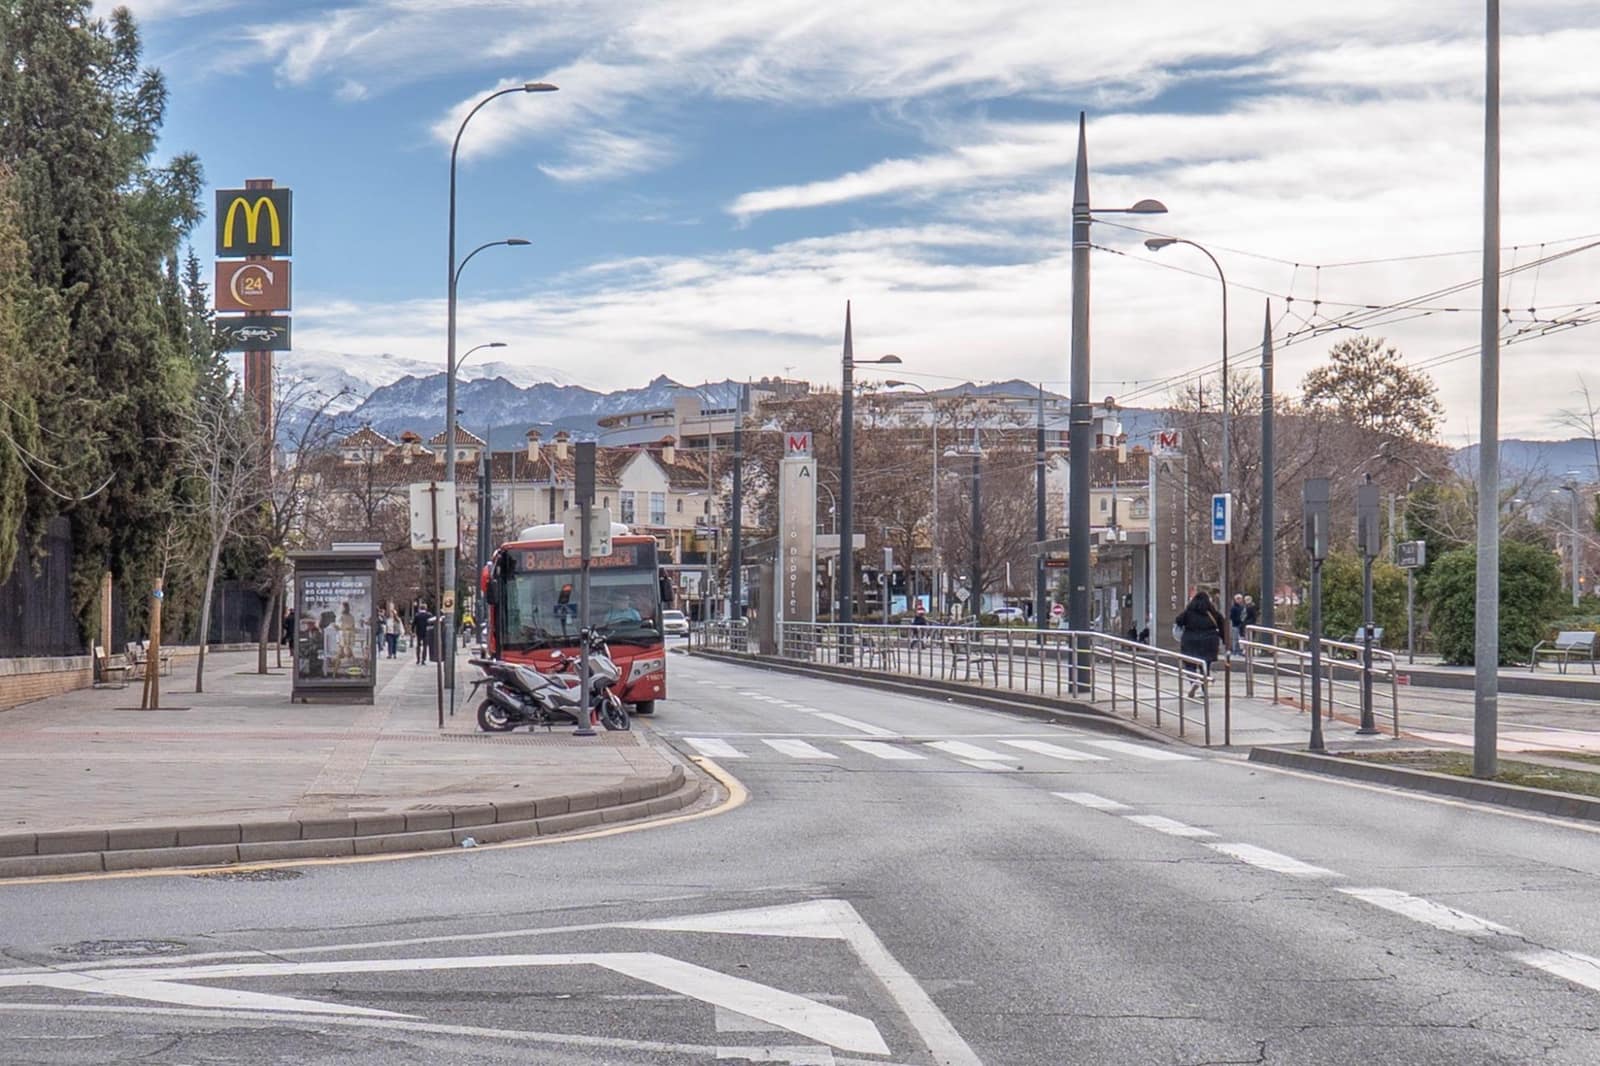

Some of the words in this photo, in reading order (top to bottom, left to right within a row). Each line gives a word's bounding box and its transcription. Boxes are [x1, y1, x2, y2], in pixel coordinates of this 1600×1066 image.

[245, 277, 263, 290] 24
[788, 436, 808, 452] M
[1160, 432, 1178, 449] M
[526, 551, 537, 570] 8
[315, 582, 330, 590] que
